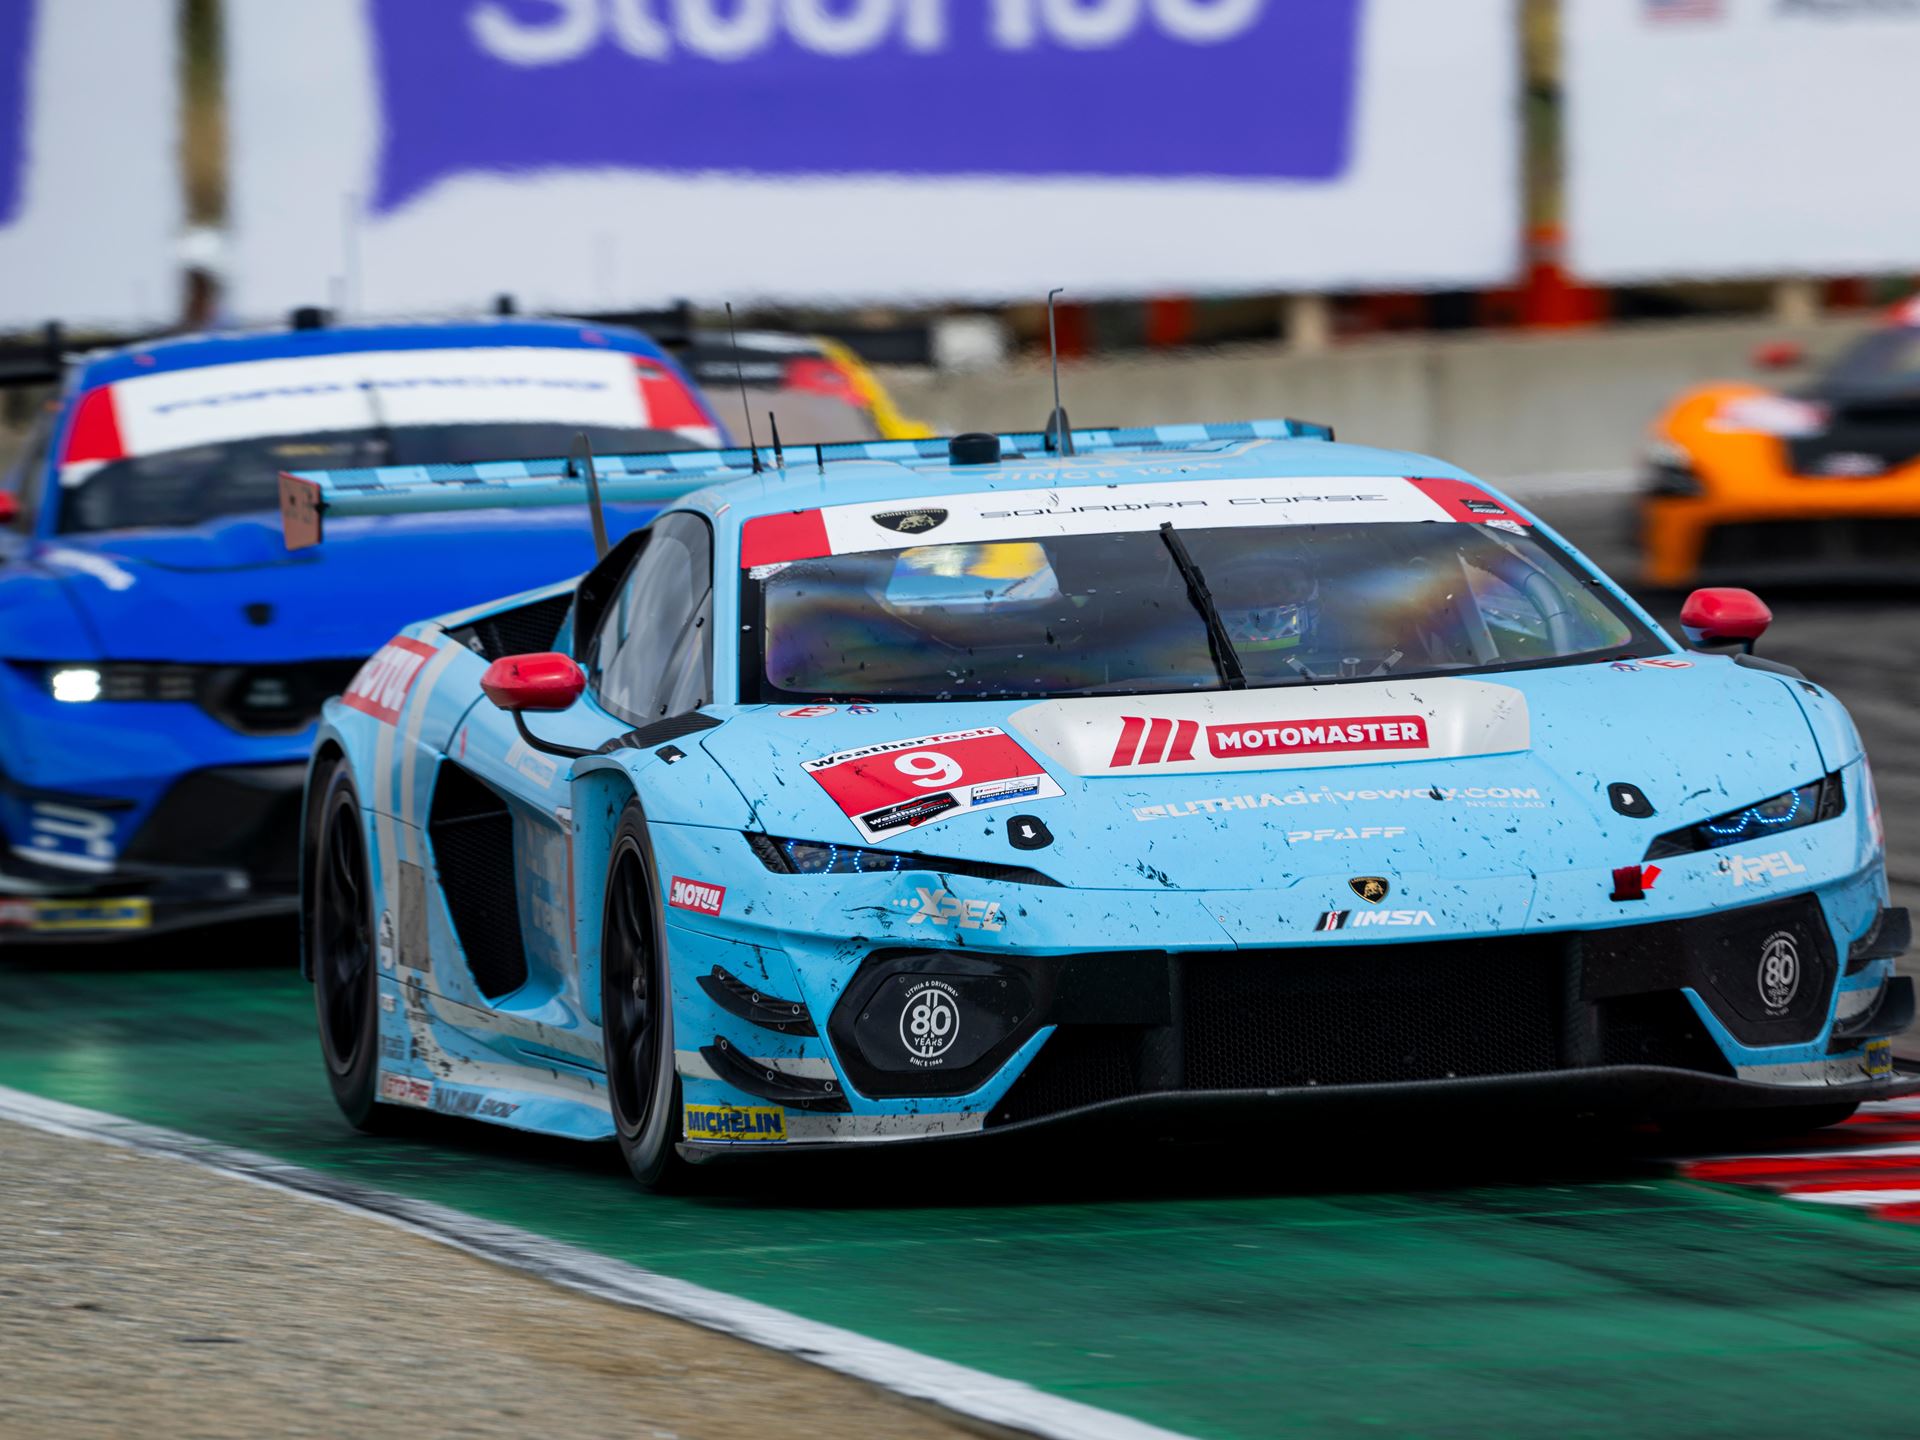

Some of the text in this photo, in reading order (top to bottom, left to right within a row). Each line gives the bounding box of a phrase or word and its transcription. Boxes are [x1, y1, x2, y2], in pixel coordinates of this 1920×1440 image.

[980, 494, 1389, 518] SQUADRA CORSE
[810, 727, 995, 768] WeatherTech
[1216, 722, 1420, 750] MOTOMASTER
[894, 751, 963, 788] 9
[1287, 825, 1407, 844] PFAFF
[1733, 850, 1807, 887] XPEL
[671, 881, 721, 911] MOTUL
[906, 887, 1002, 932] XPEL
[1352, 910, 1437, 928] IMSA
[1765, 954, 1795, 987] 80
[905, 982, 925, 998] LITHIA
[930, 980, 959, 997] DRIVEWAY
[911, 1005, 951, 1035] 80
[914, 1037, 943, 1047] YEARS
[687, 1110, 783, 1133] MICHELIN
